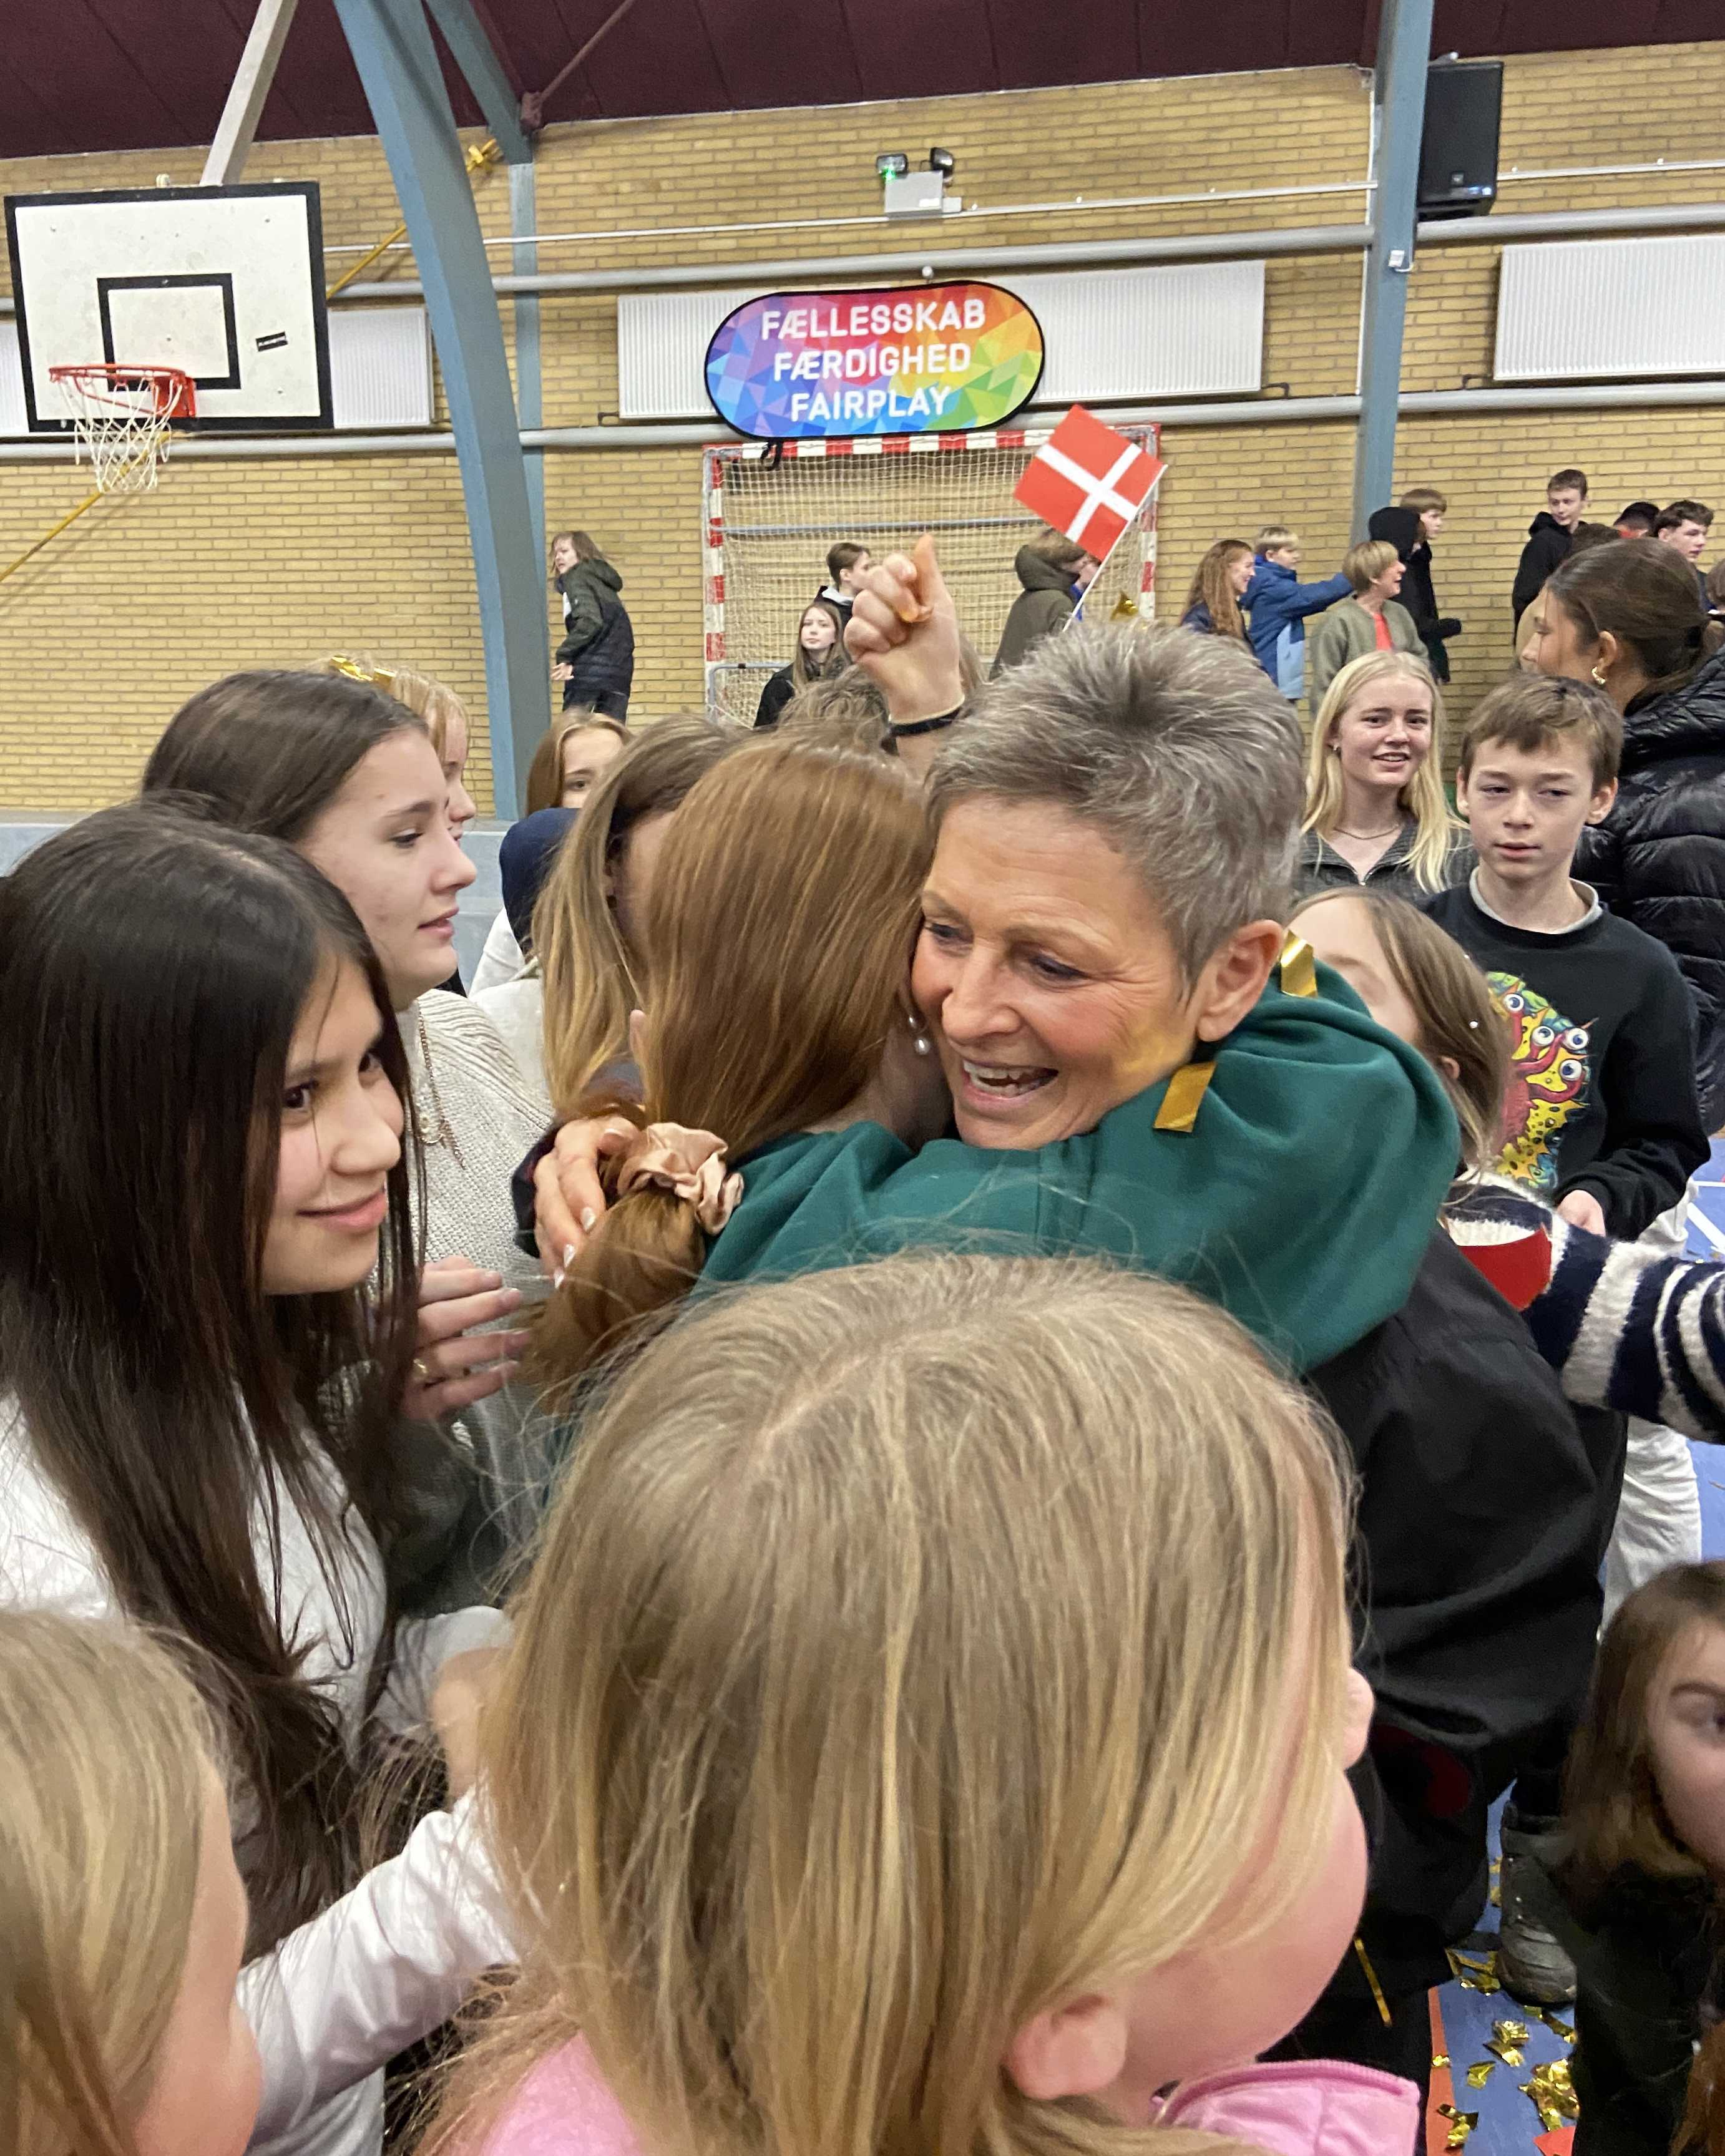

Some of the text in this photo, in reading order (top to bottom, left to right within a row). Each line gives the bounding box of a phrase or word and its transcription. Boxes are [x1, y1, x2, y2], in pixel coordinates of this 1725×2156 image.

[761, 300, 986, 340] FÆLLESSKAB
[774, 343, 971, 381] FÆRDIGHED
[791, 386, 951, 422] FAIRPLAY
